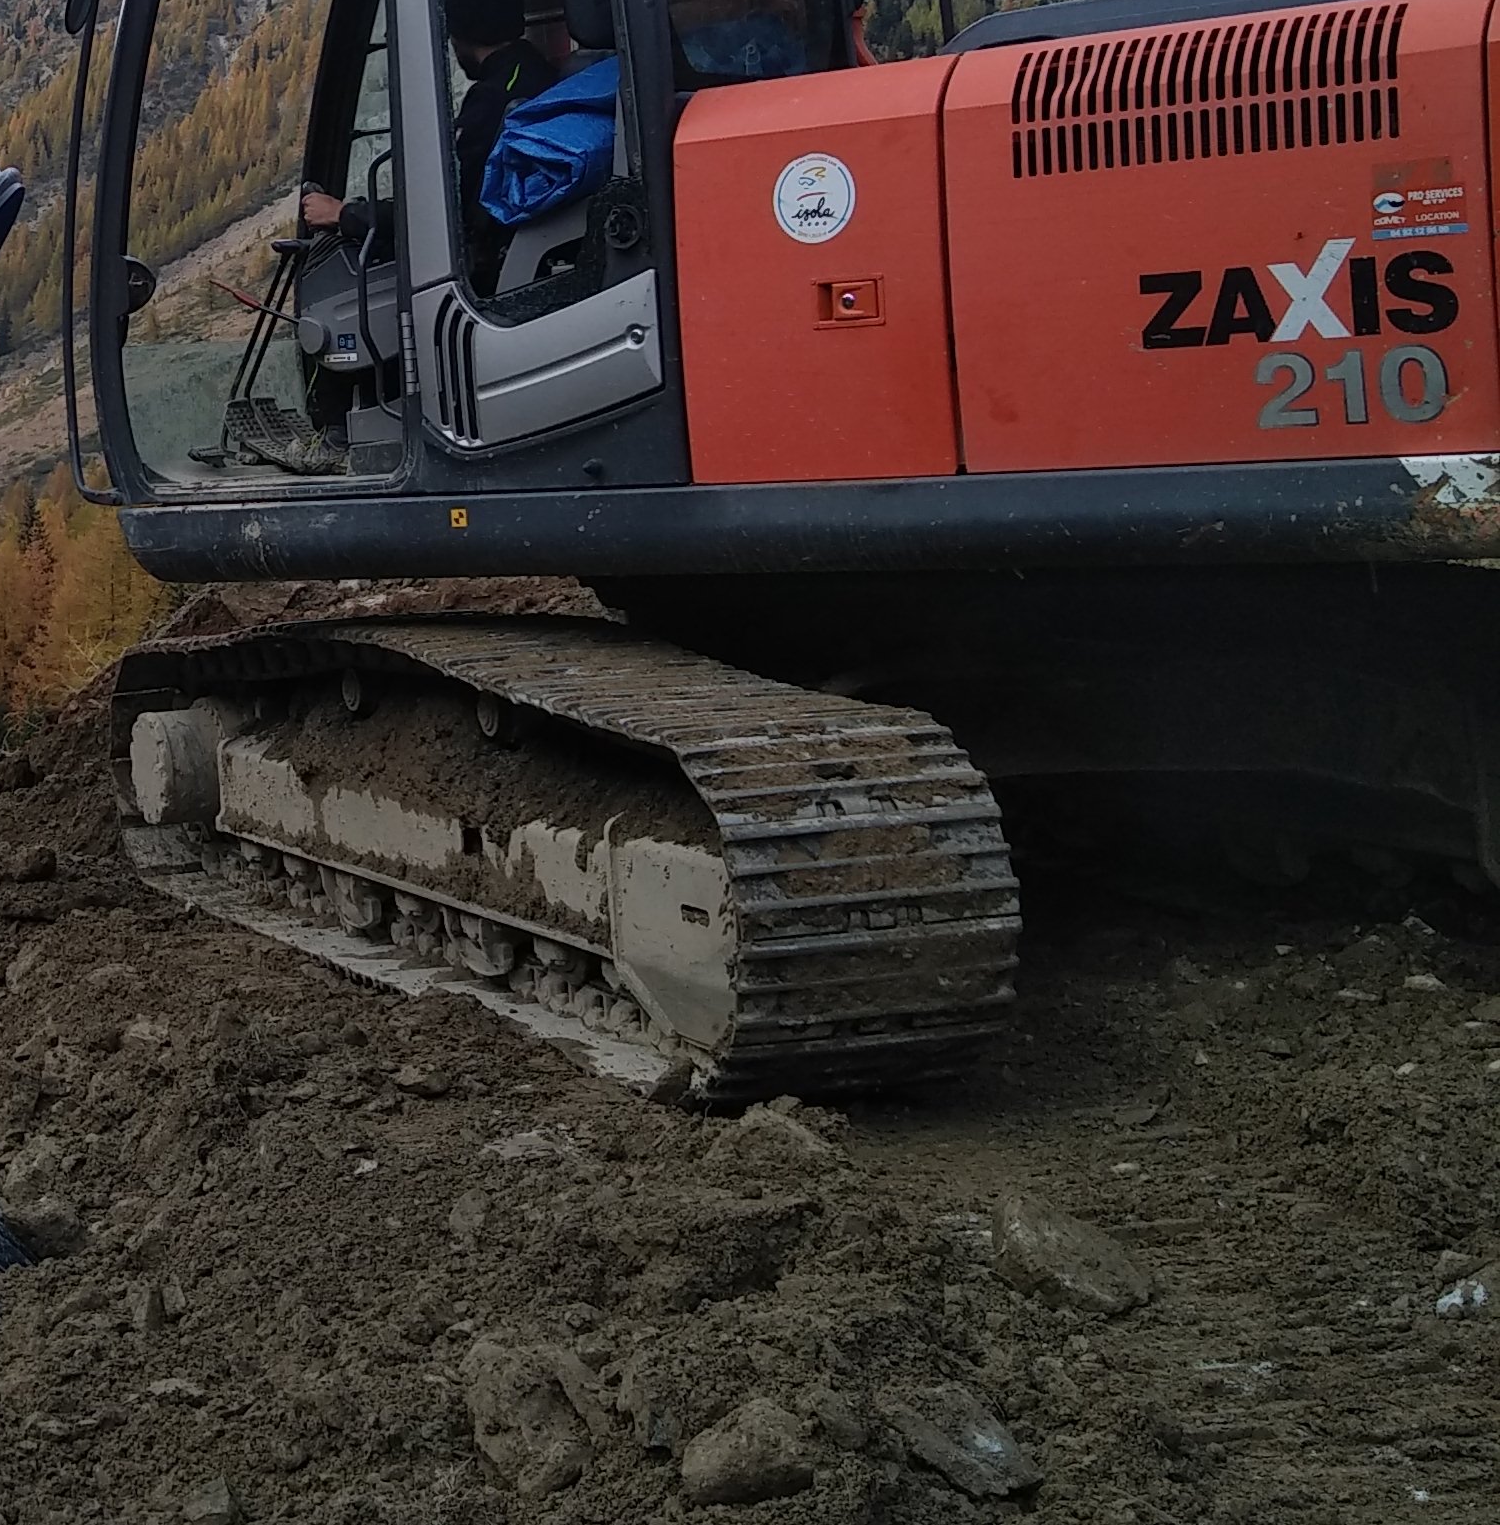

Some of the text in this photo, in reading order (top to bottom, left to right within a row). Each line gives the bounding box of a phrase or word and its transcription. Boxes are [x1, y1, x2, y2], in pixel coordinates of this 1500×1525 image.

[1407, 187, 1463, 201] PRO SERVICES
[791, 196, 838, 221] isola
[1415, 211, 1460, 222] LOCATION
[1139, 237, 1459, 349] ZAXIS
[1255, 344, 1449, 429] 210
